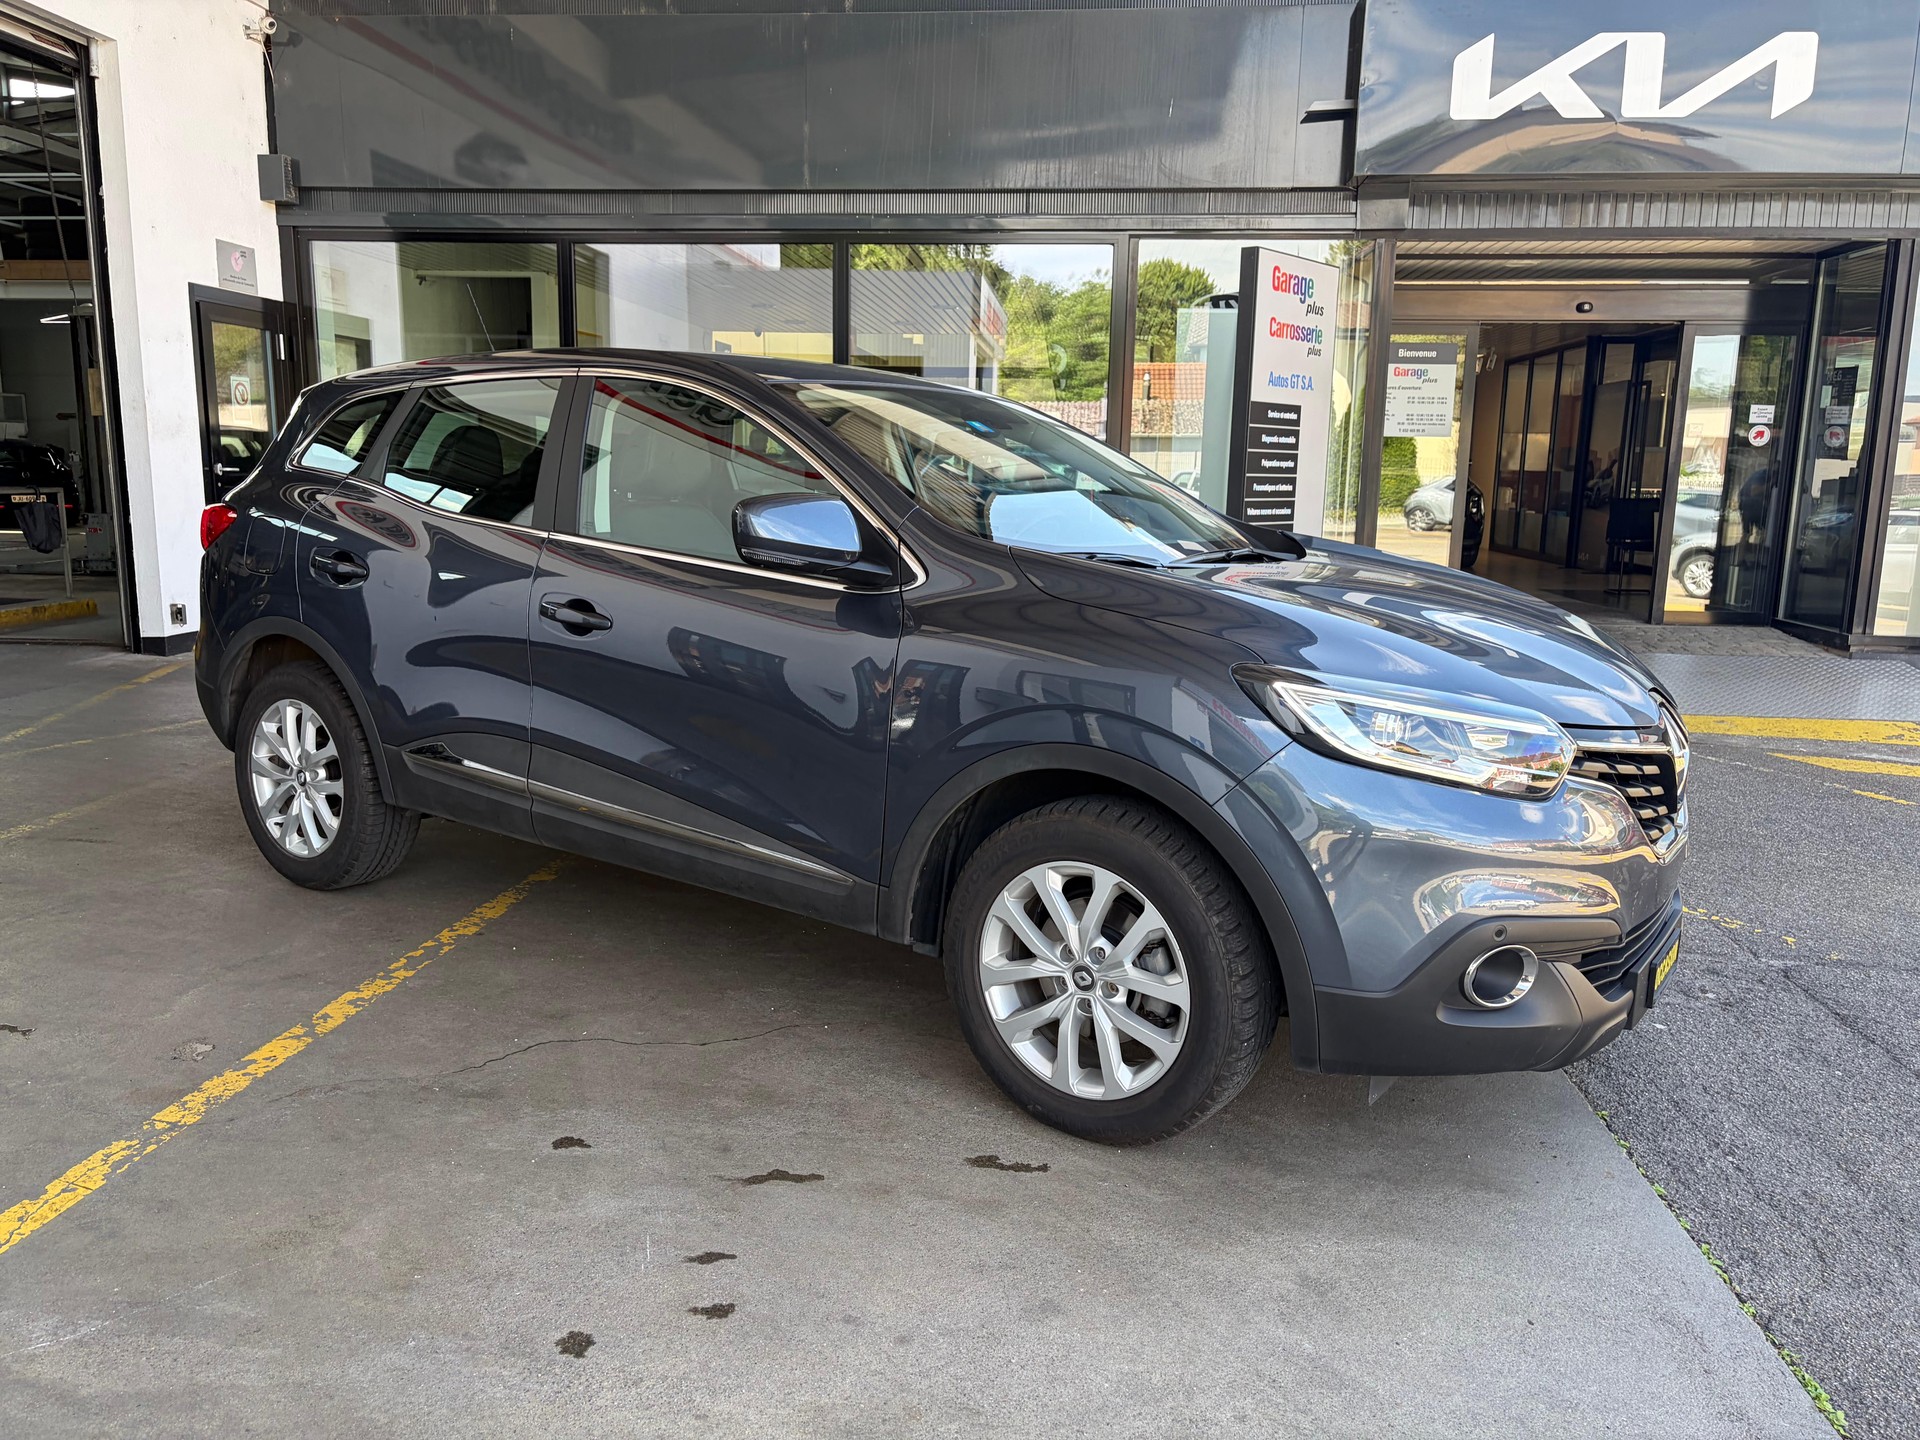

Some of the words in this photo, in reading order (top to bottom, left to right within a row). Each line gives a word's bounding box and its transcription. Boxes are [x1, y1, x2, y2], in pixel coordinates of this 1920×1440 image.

[1272, 265, 1314, 304] Garage
[1305, 301, 1324, 317] plus
[1269, 316, 1322, 345] Carrosserie
[1307, 345, 1322, 357] plus
[1398, 349, 1437, 358] Bienvenue
[1393, 366, 1429, 379] Garage
[1268, 371, 1289, 389] Autos
[1290, 374, 1300, 390] GT
[1301, 375, 1314, 391] S.A.
